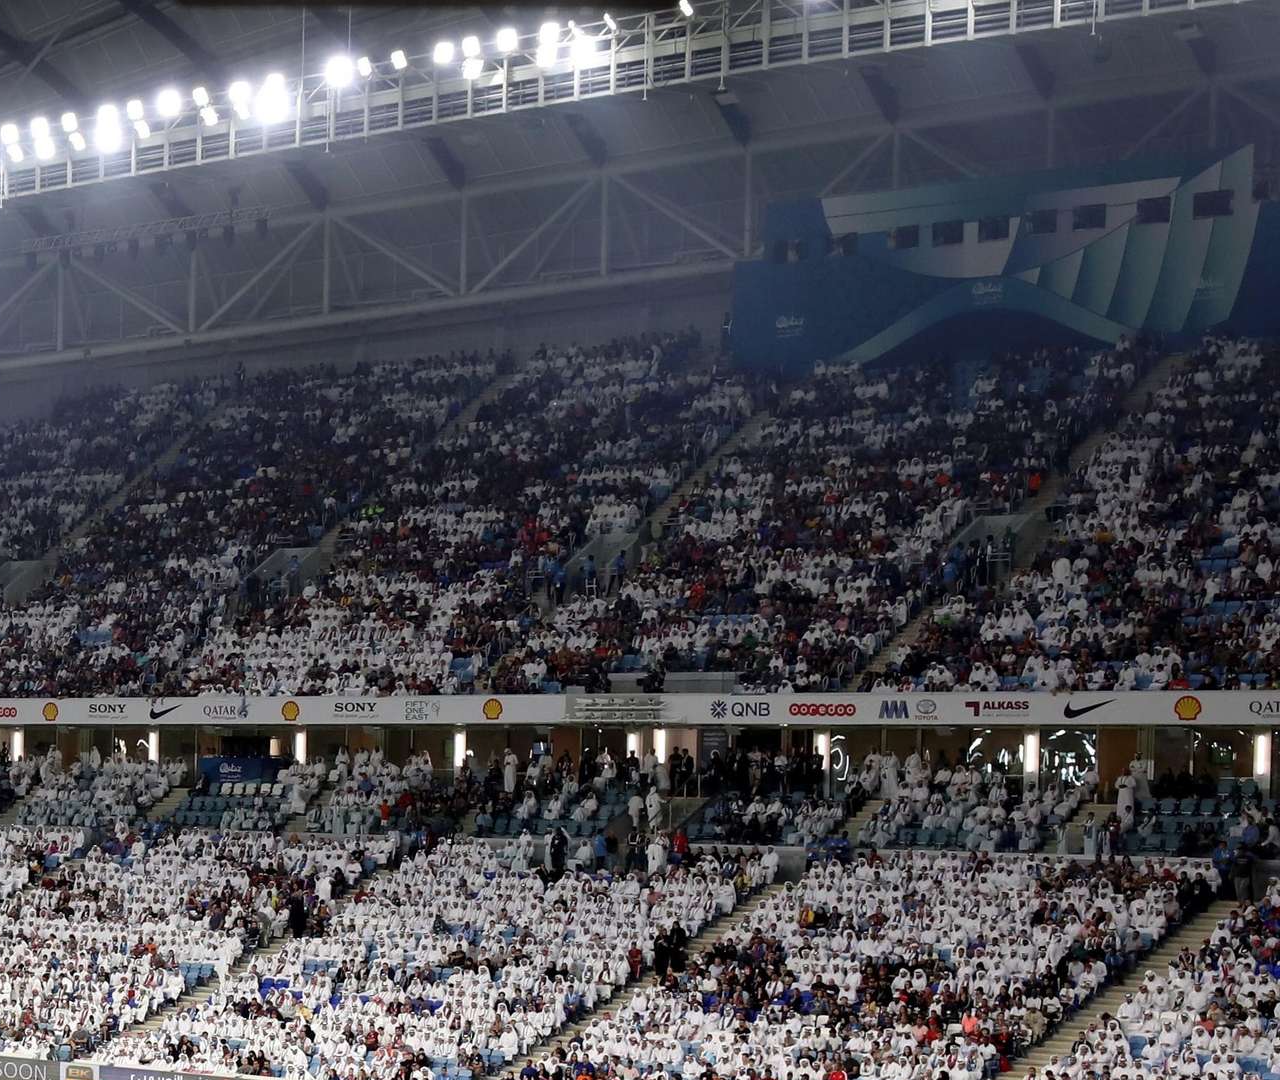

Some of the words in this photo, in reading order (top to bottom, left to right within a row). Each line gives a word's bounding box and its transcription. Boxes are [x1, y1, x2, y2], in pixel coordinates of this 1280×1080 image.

[88, 704, 126, 713] SONY
[334, 702, 377, 712] SONY
[731, 702, 770, 717] QNB
[789, 703, 856, 716] ooredoo
[983, 701, 1029, 710] ALKASS
[203, 706, 236, 717] QATAR
